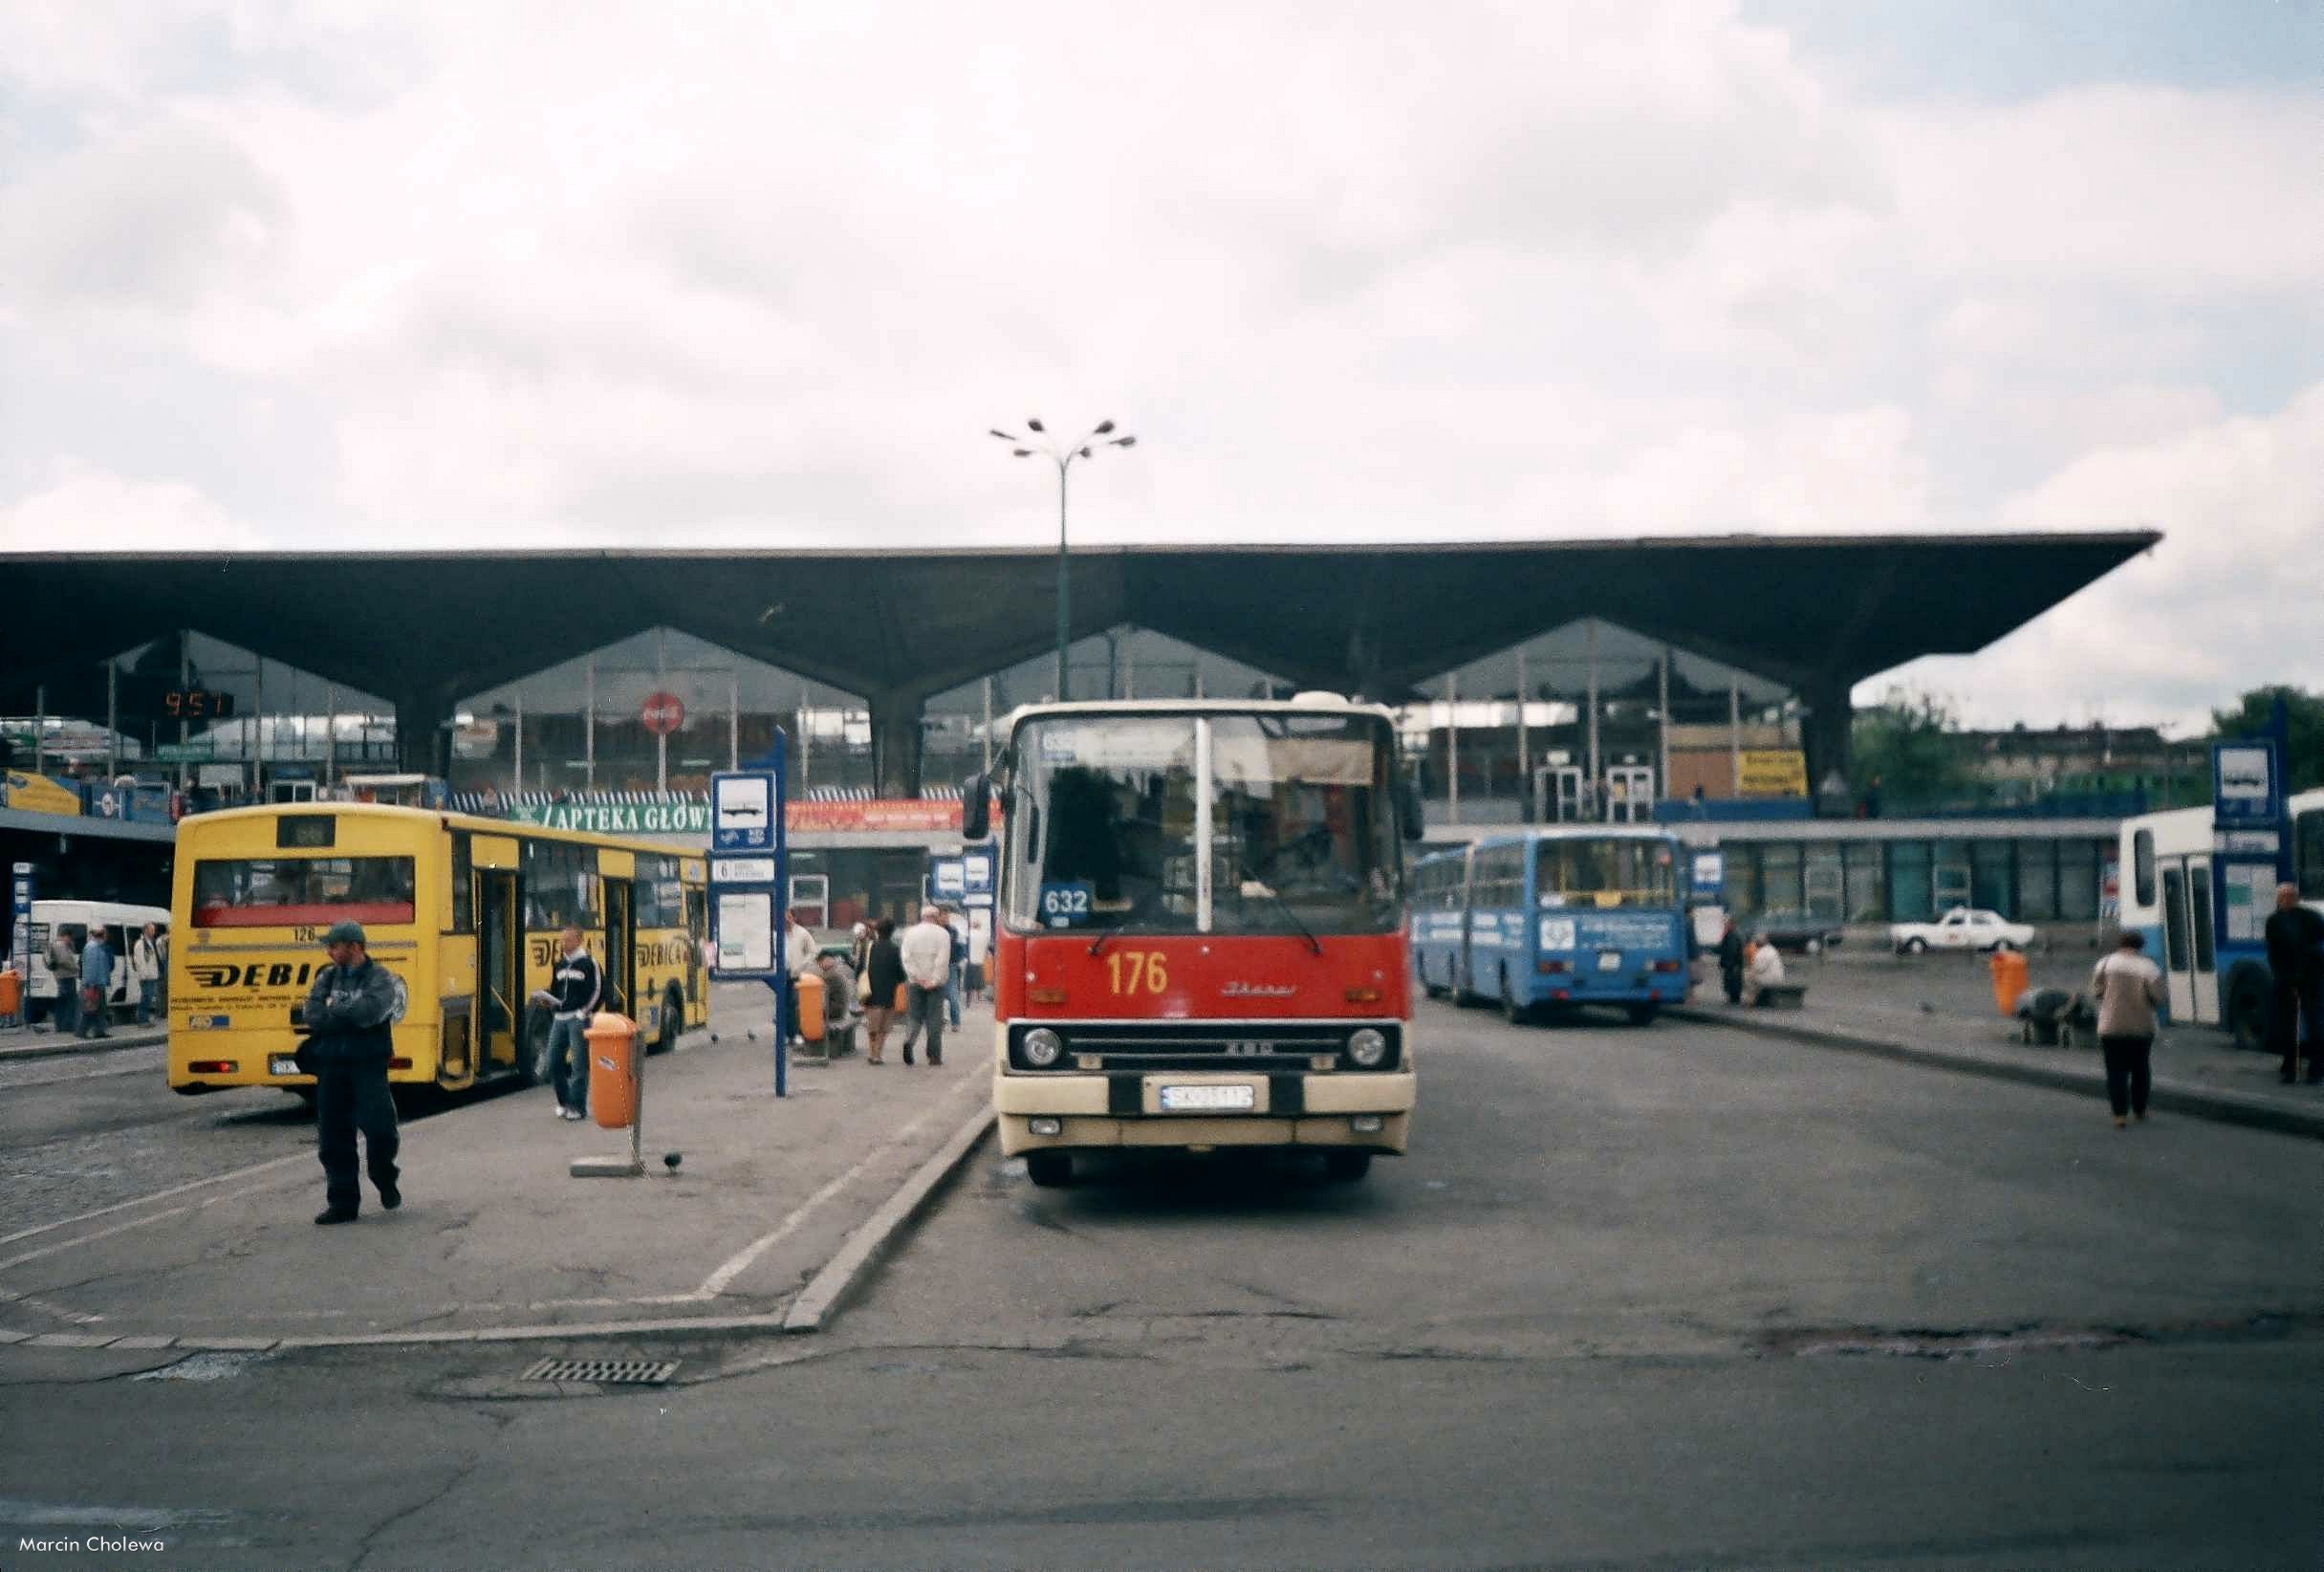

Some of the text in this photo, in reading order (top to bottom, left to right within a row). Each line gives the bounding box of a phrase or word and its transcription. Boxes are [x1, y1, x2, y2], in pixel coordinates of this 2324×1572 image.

[556, 805, 639, 831] APTEKA
[1045, 890, 1088, 913] 632
[1107, 951, 1168, 995] 176
